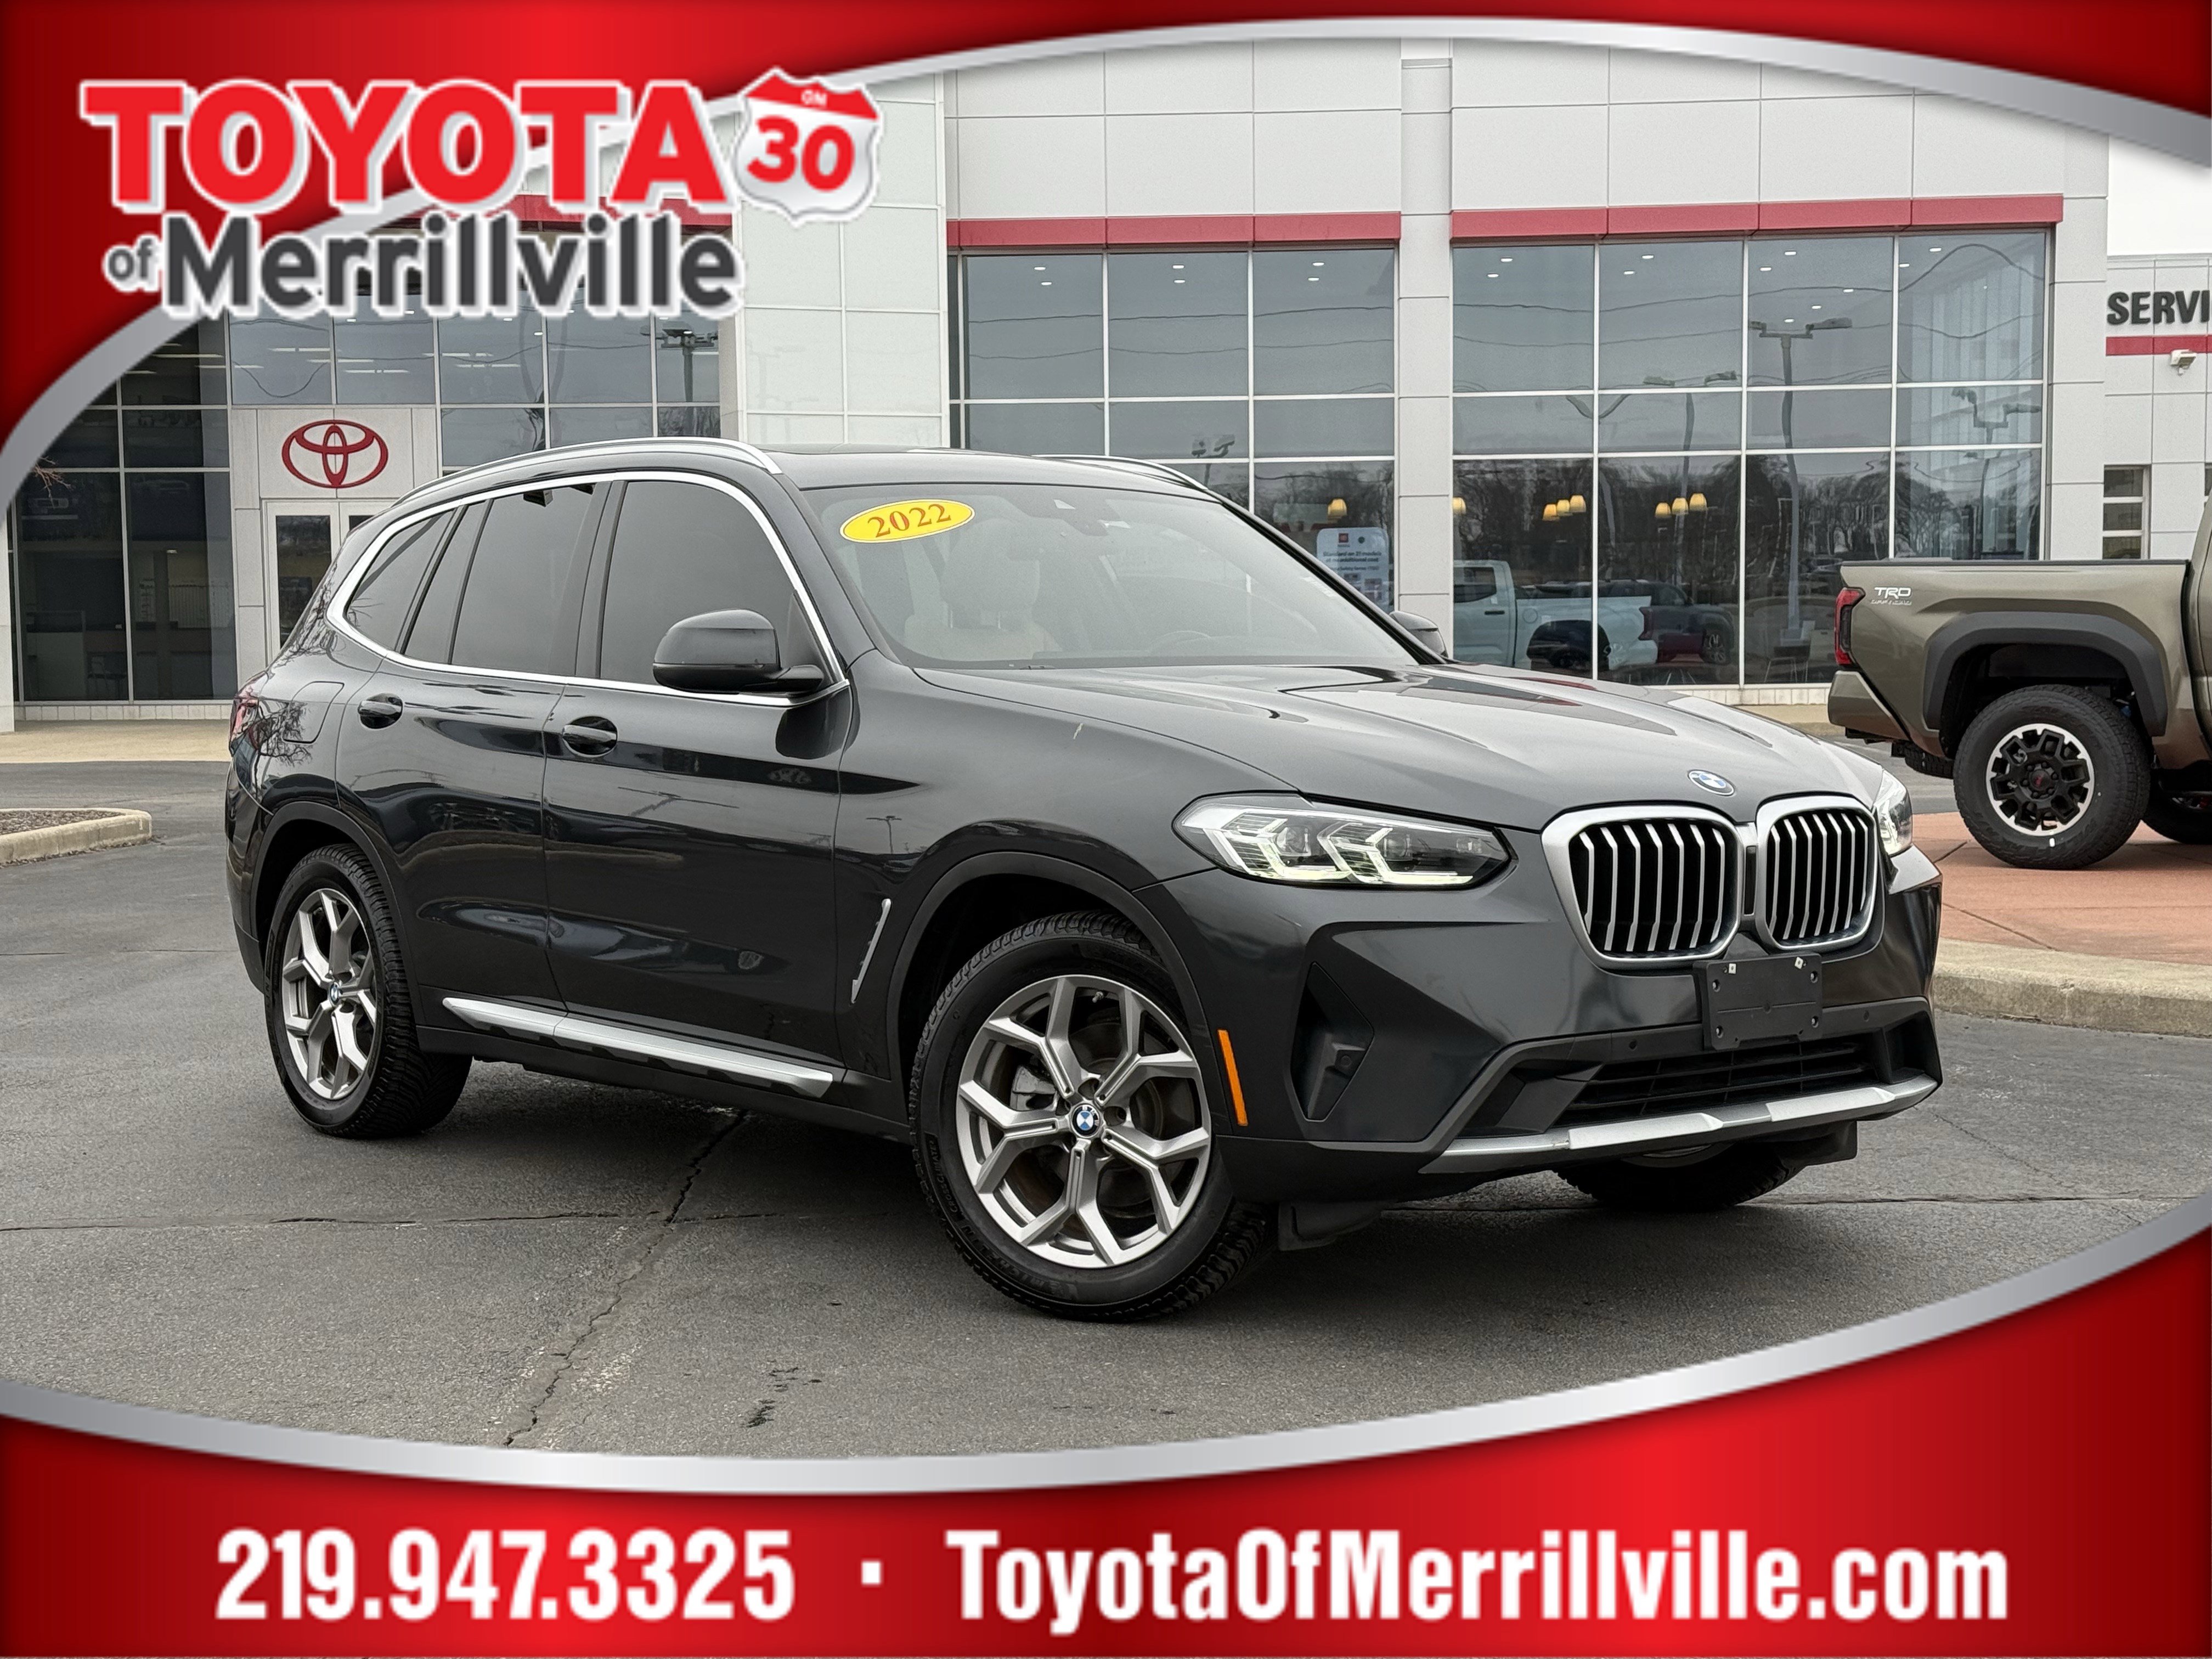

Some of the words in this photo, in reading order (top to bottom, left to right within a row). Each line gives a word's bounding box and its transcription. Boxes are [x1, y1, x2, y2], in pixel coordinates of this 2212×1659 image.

[2107, 290, 2210, 326] SERVI
[867, 503, 952, 538] 2022
[1874, 586, 1911, 599] TRD
